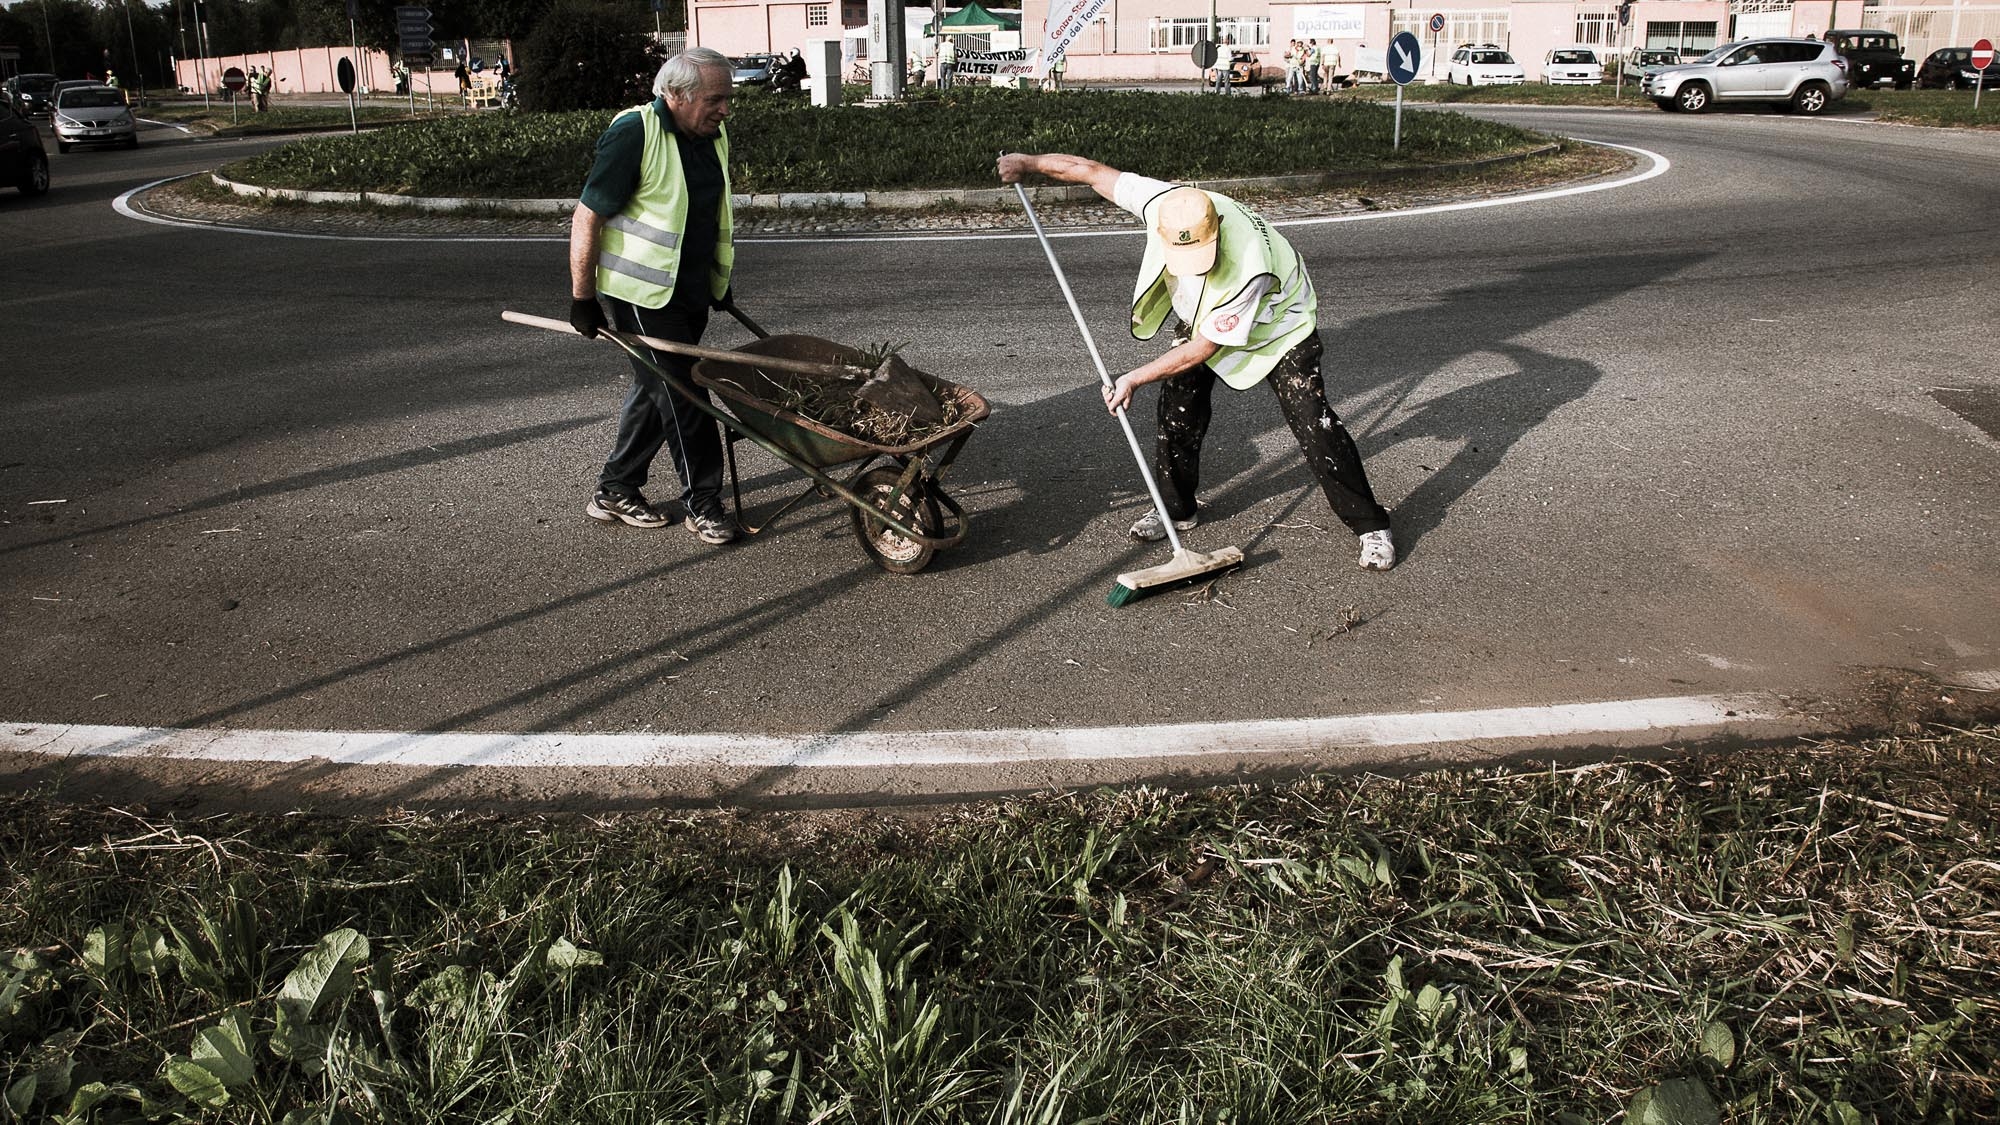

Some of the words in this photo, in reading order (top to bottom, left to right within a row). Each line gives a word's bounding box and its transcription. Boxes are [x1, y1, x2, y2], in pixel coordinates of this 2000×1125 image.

[1051, 15, 1073, 40] Centro
[1297, 20, 1361, 34] opacmare
[1047, 38, 1070, 64] Sagra
[1069, 21, 1083, 38] del
[1000, 64, 1033, 75] all'opera
